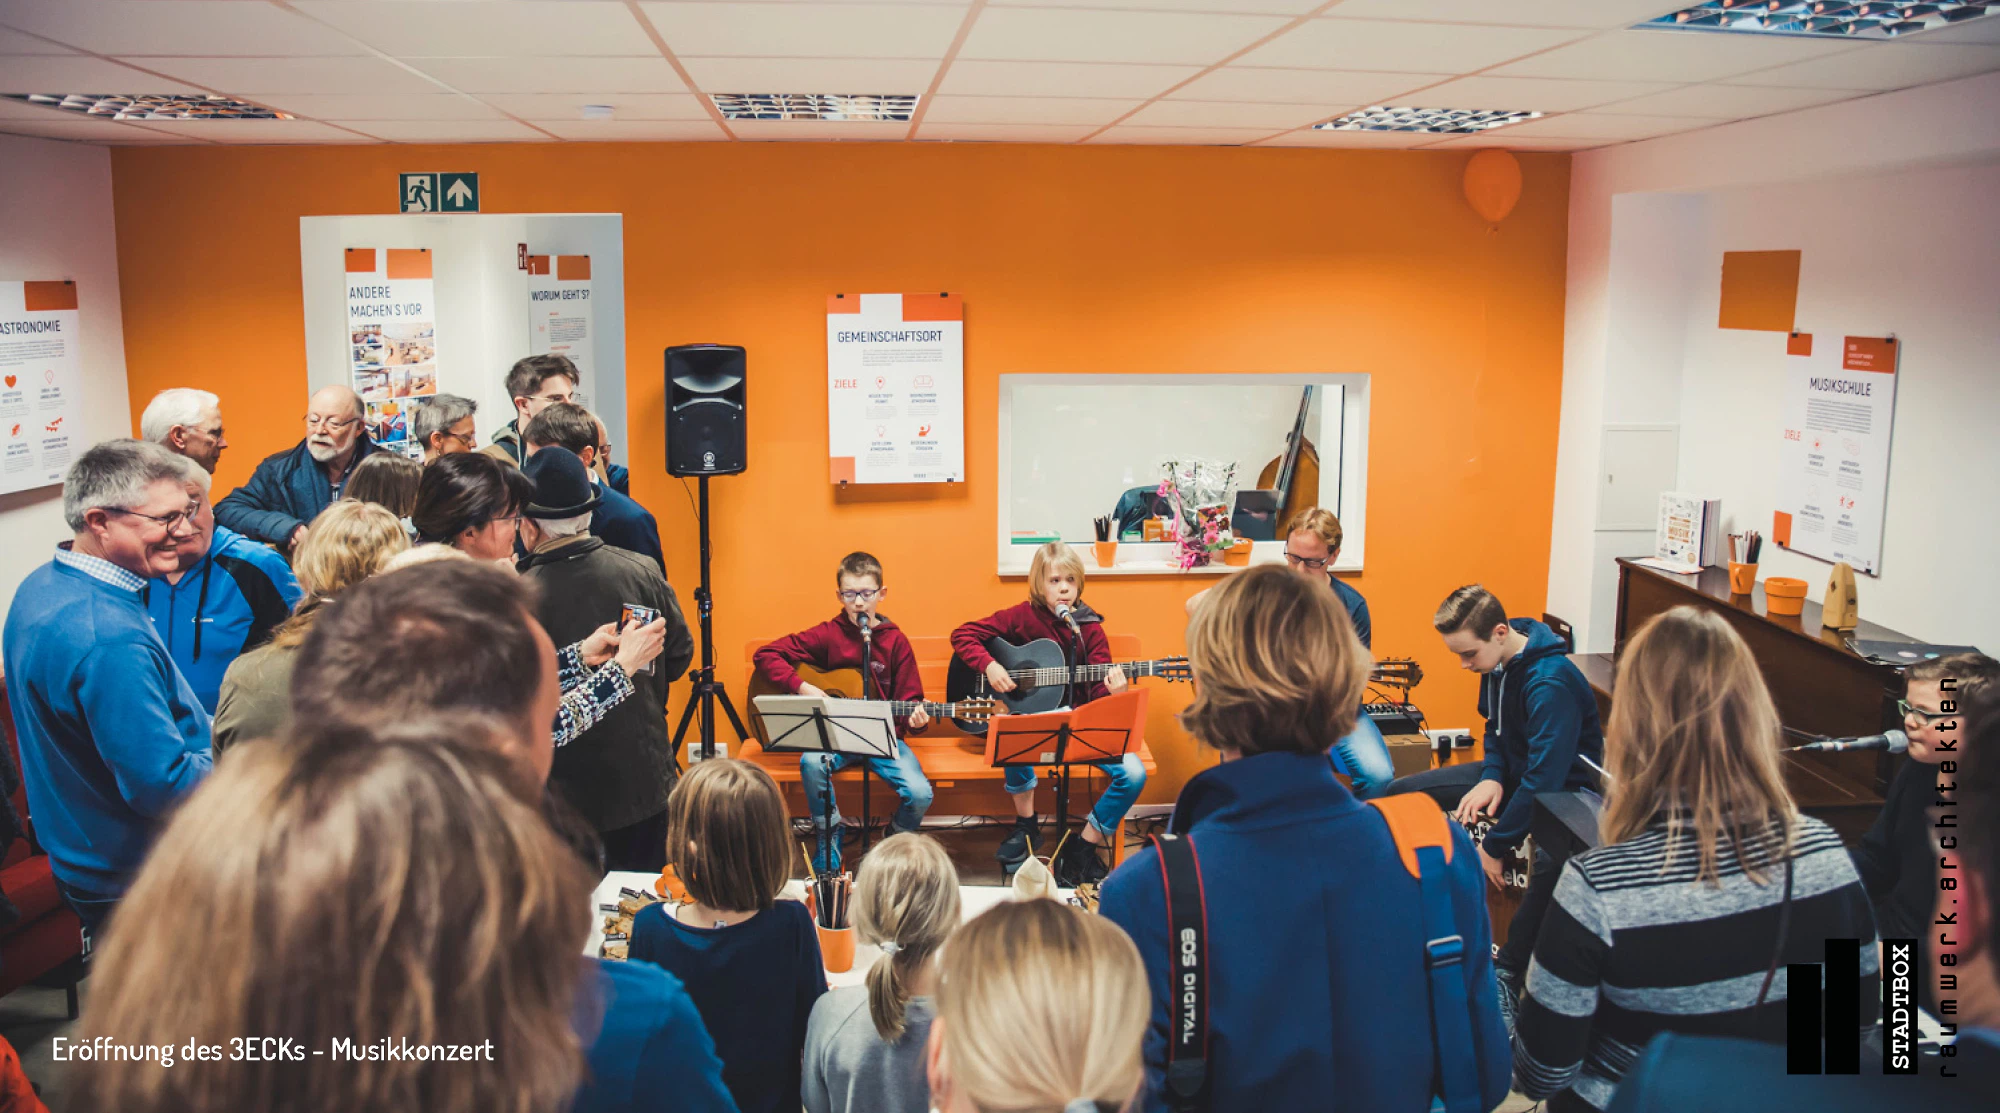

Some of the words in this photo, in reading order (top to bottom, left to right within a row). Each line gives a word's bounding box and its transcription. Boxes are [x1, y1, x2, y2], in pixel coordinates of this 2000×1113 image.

[349, 285, 391, 299] ANDERE
[531, 290, 560, 301] WORUM
[403, 302, 422, 316] VOR
[837, 330, 943, 343] GEMEINSCHAFTSORT
[834, 378, 857, 389] ZIELE
[1810, 377, 1872, 397] MUSIKSCHULE
[1180, 928, 1197, 967] EOS
[1183, 972, 1196, 1044] DIGITAL
